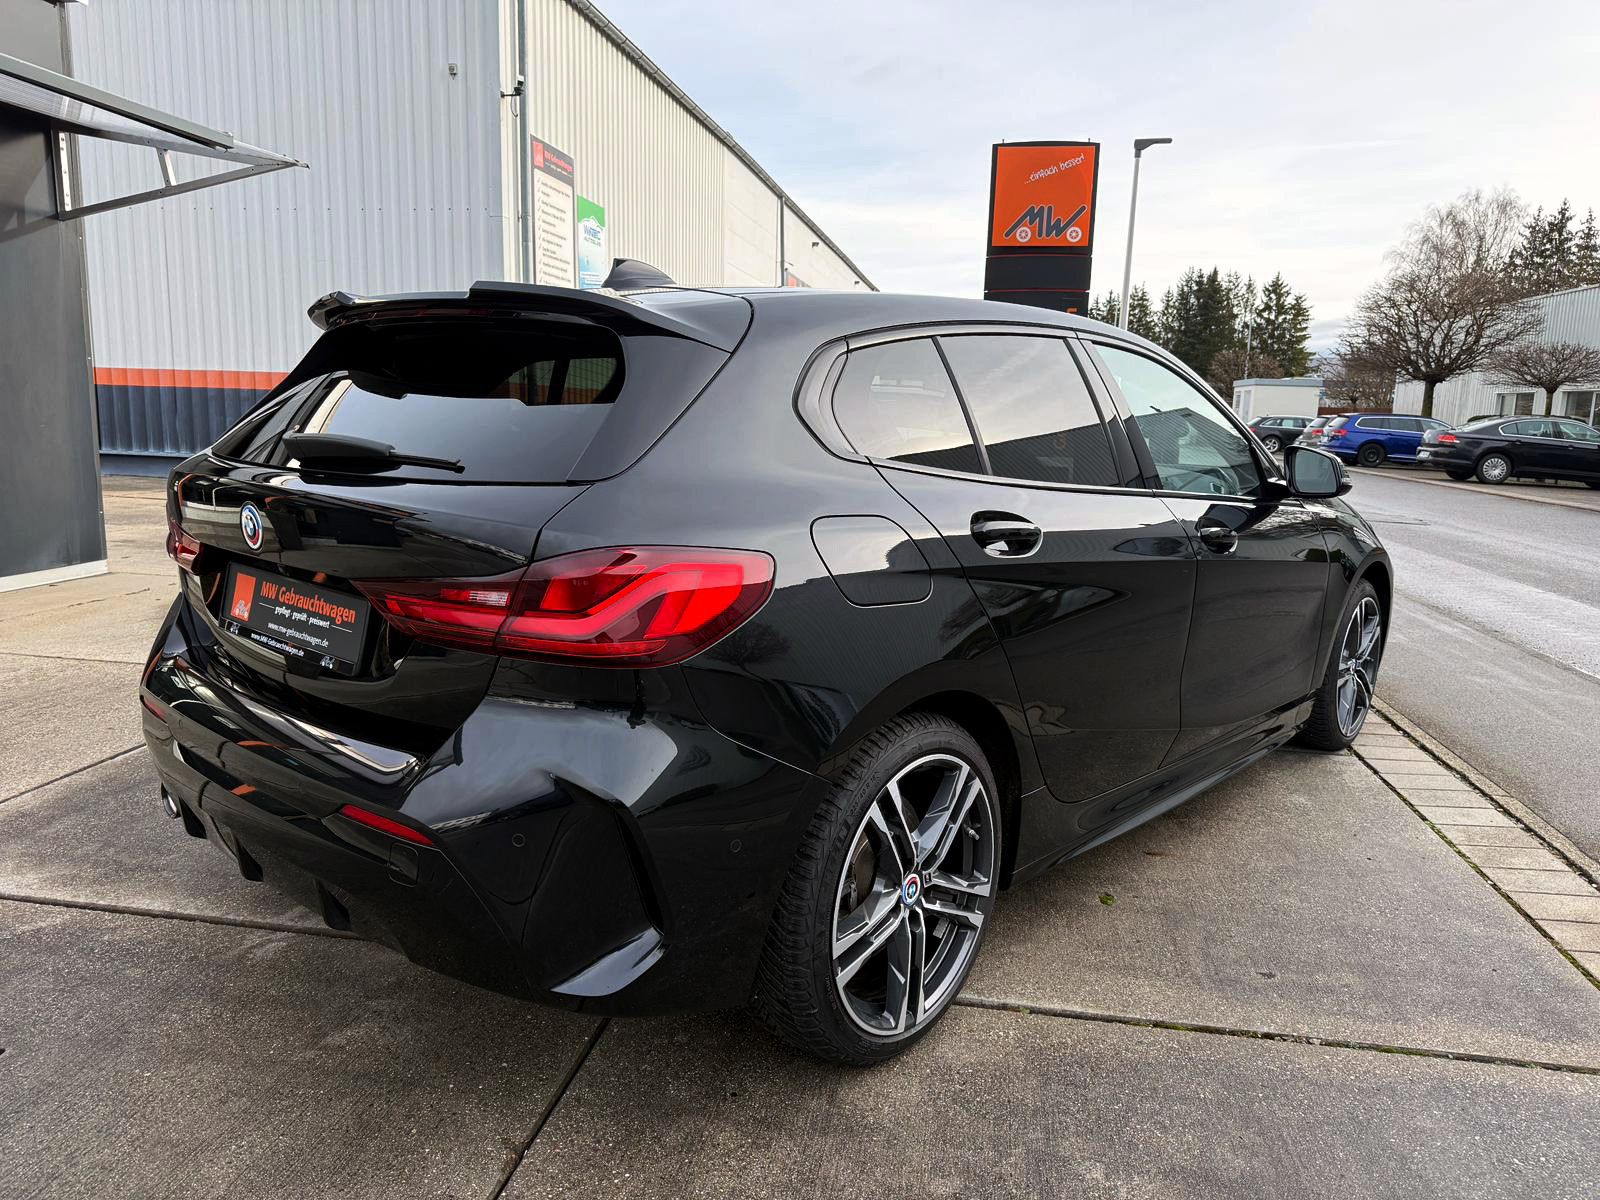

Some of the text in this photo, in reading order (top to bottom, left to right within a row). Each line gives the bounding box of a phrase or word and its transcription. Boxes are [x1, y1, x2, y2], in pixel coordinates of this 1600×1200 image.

[1003, 204, 1088, 240] MW
[260, 581, 279, 600] MW
[279, 586, 356, 625] Gebrauchtwagen
[267, 622, 329, 648] www.mw-gebrauchtwagen.de
